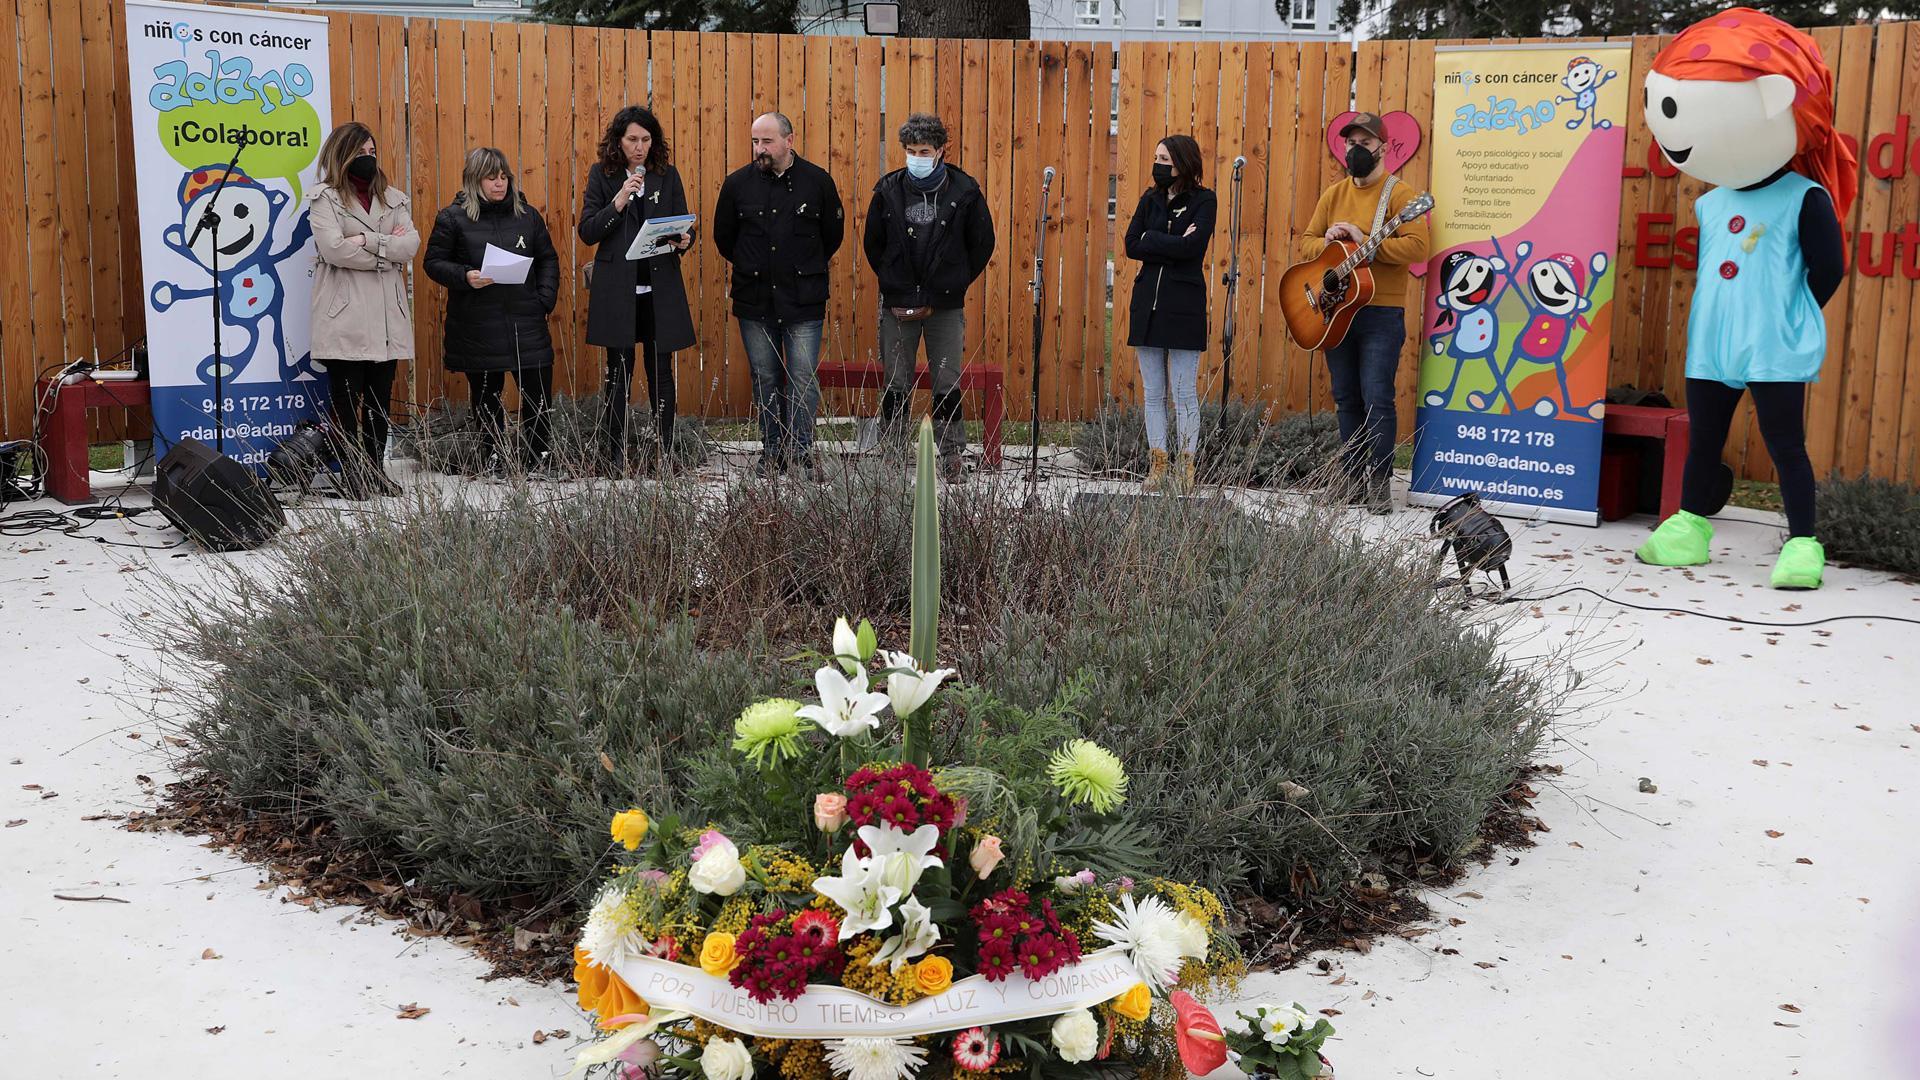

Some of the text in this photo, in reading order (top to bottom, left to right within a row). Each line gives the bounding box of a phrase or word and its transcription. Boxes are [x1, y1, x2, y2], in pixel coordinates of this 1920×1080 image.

[209, 30, 243, 45] con
[249, 30, 312, 50] cáncer
[149, 50, 313, 114] adano
[1485, 73, 1508, 84] con
[1512, 70, 1558, 83] cáncer
[1451, 95, 1555, 137] adano
[1456, 149, 1481, 158] Apoyo
[1484, 149, 1530, 158] psicológico
[1539, 150, 1563, 158] social
[1461, 162, 1529, 171] Apoyo educativo
[1464, 174, 1514, 182] Voluntariado
[1463, 186, 1536, 195] Apoyo económico
[1462, 198, 1511, 207] Tiempo libre
[1454, 210, 1512, 219] Sensibilización
[1444, 222, 1491, 231] Información
[240, 396, 270, 411] 172
[275, 395, 305, 410] 178
[1457, 424, 1555, 447] 948 172 178
[1434, 449, 1576, 476] adano@adano.es
[1442, 476, 1564, 500] www.adano.es
[649, 972, 695, 998] POR
[711, 991, 799, 1024] VUESTRO
[817, 1003, 906, 1024] TIEMPO
[995, 985, 1008, 1003] Y
[1027, 964, 1129, 1000] COMPAÑÍA
